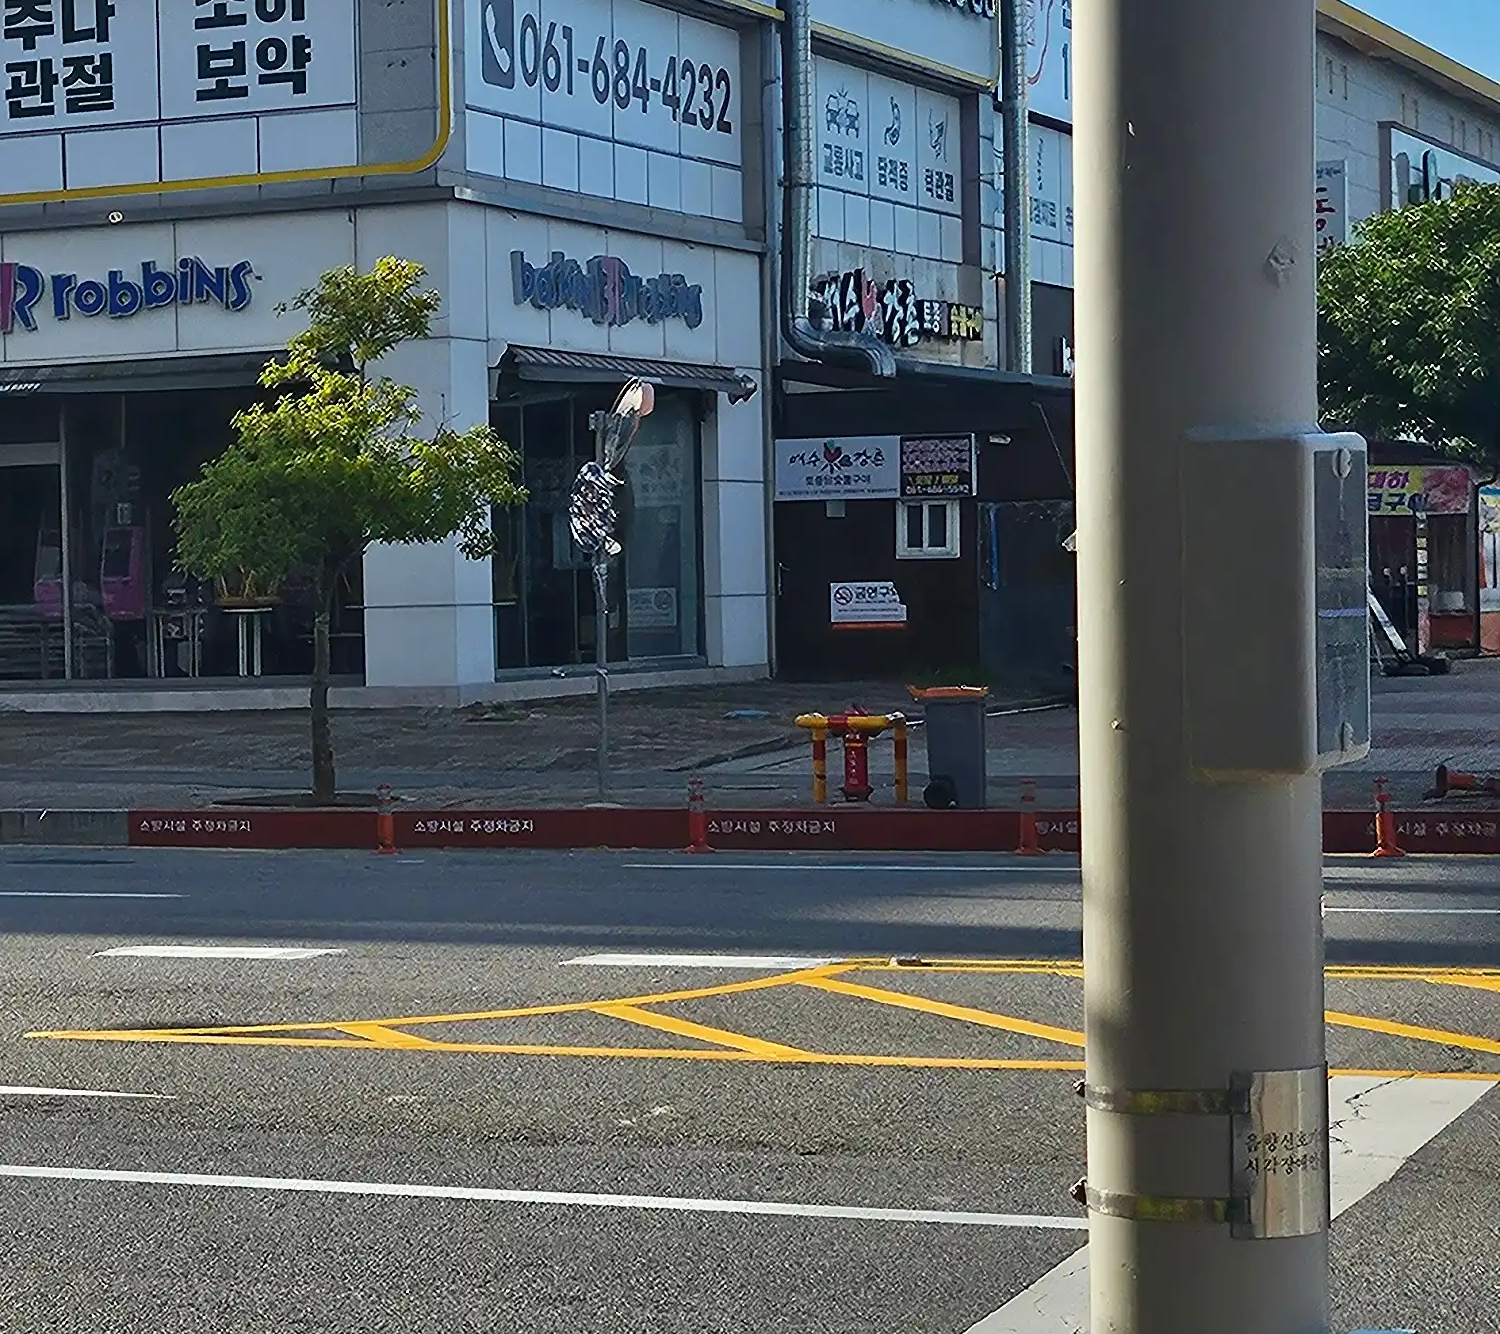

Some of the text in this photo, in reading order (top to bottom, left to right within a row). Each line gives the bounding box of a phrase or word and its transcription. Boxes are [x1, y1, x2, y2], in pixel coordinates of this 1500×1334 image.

[5, 52, 115, 119] 관절
[195, 35, 311, 102] 보약
[520, 12, 733, 135] 061-684-4232
